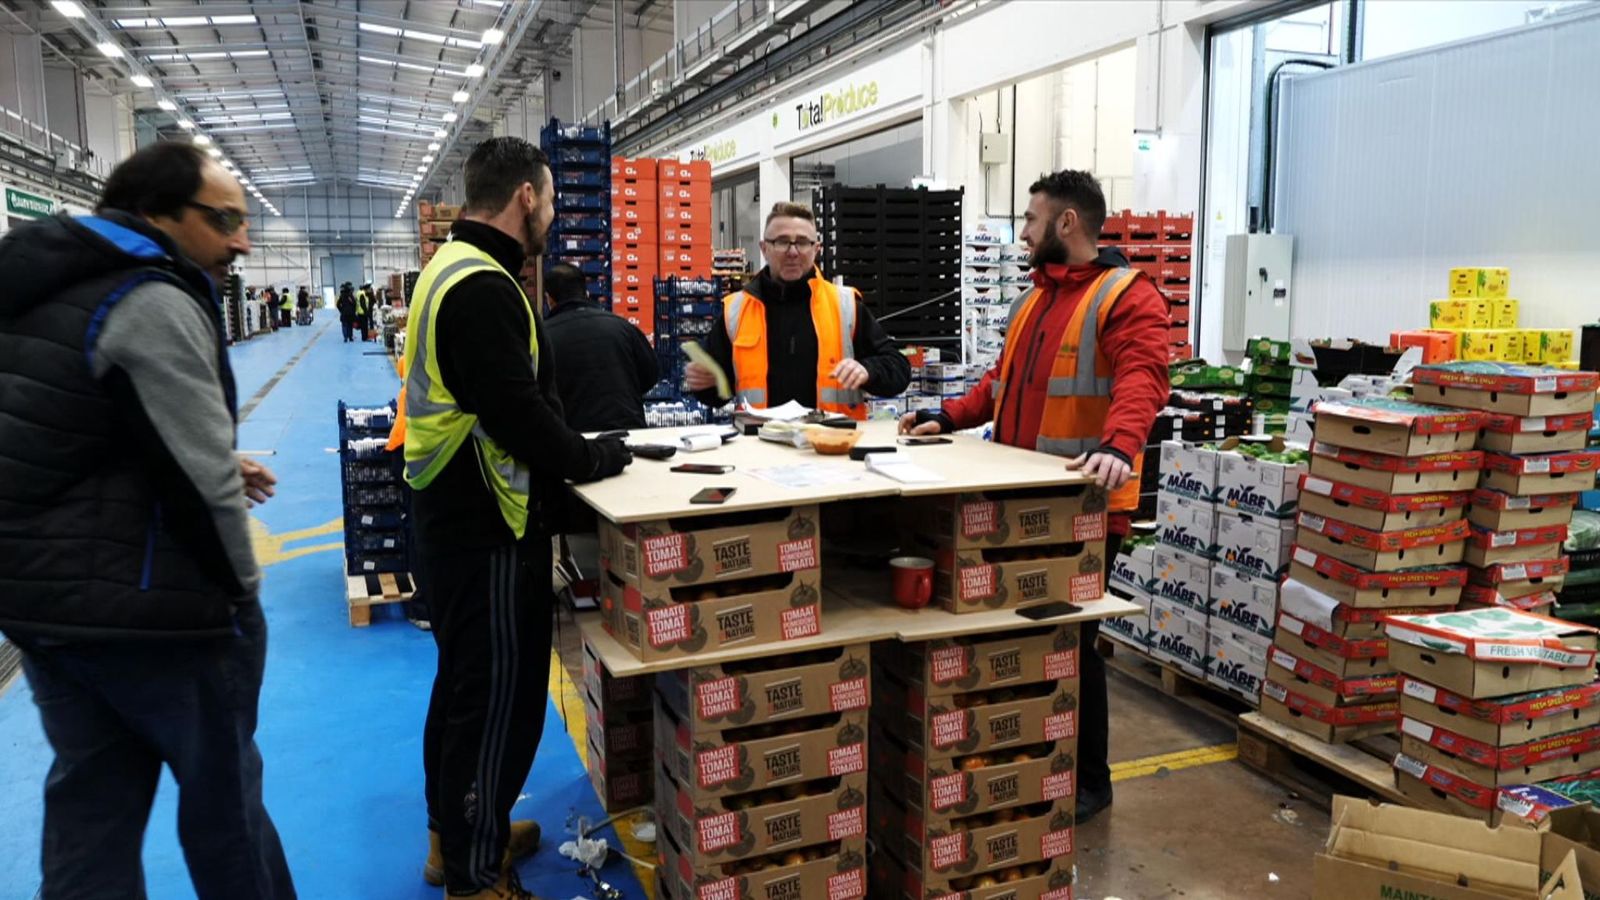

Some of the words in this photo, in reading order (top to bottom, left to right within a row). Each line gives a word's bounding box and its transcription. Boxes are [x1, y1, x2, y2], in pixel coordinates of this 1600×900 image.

[964, 502, 994, 514] TOMATO
[964, 511, 992, 525] TOMAT
[1019, 513, 1049, 528] TASTE
[1074, 513, 1101, 524] TOMAAT
[965, 524, 993, 535] TOMATE
[1074, 529, 1103, 541] TOMATO
[645, 534, 682, 549] TOMATO
[779, 541, 812, 556] TOMAAT
[646, 545, 682, 561] TOMAT
[713, 541, 750, 561] TASTE
[648, 559, 684, 574] TOMATE
[721, 556, 752, 570] NATURE
[781, 557, 815, 572] TOMATO
[962, 566, 991, 578] TOMATO
[963, 576, 990, 588] TOMAT
[1017, 575, 1047, 590] TASTE
[1072, 574, 1099, 586] TOMAAT
[963, 586, 991, 598] TOMATE
[1072, 590, 1100, 602] TOMATO
[649, 604, 685, 621] TOMATO
[782, 608, 814, 621] TOMAAT
[650, 616, 685, 633] TOMAT
[717, 609, 753, 632] TASTE
[652, 630, 687, 644] TOMATE
[725, 625, 754, 639] NATURE
[785, 624, 817, 639] TOMATO
[933, 648, 963, 661] TOMATO
[1045, 651, 1073, 664] TOMAAT
[1490, 645, 1524, 657] FRESH
[934, 657, 962, 671] TOMAT
[990, 653, 1020, 670] TASTE
[934, 669, 963, 682] TOMATE
[1046, 667, 1075, 680] TOMATO
[699, 678, 735, 694] TOMATO
[831, 679, 863, 693] TOMAAT
[700, 689, 734, 706] TOMAT
[765, 684, 802, 704] TASTE
[702, 702, 736, 716] TOMATE
[833, 696, 866, 711] TOMATO
[933, 711, 964, 724] TOMATO
[990, 716, 1020, 733] TASTE
[1045, 712, 1073, 725] TOMAAT
[934, 721, 963, 735] TOMAT
[1046, 728, 1074, 741] TOMATO
[935, 733, 963, 745] TOMATE
[700, 746, 734, 763] TOMATO
[829, 744, 861, 759] TOMAAT
[701, 757, 734, 773] TOMAT
[764, 751, 800, 770] TASTE
[831, 761, 863, 776] TOMATO
[702, 771, 736, 785] TOMATE
[932, 773, 963, 787] TOMATO
[988, 776, 1018, 794] TASTE
[1042, 772, 1071, 785] TOMAAT
[933, 784, 961, 798] TOMAT
[1043, 787, 1072, 800] TOMATO
[934, 795, 962, 809] TOMATE
[700, 812, 734, 828] TOMATO
[828, 808, 860, 823] TOMAAT
[701, 823, 734, 840] TOMAT
[765, 816, 800, 835] TASTE
[830, 824, 862, 840] TOMATO
[702, 835, 736, 850] TOMATE
[931, 833, 961, 847] TOMATO
[1042, 830, 1070, 842] TOMAAT
[933, 844, 961, 858] TOMAT
[988, 836, 1017, 853] TASTE
[1043, 845, 1071, 859] TOMATO
[934, 855, 961, 868] TOMATE
[828, 869, 860, 884] TOMAAT
[700, 877, 735, 893] TOMATO
[765, 879, 800, 898] TASTE
[830, 886, 862, 900] TOMATO
